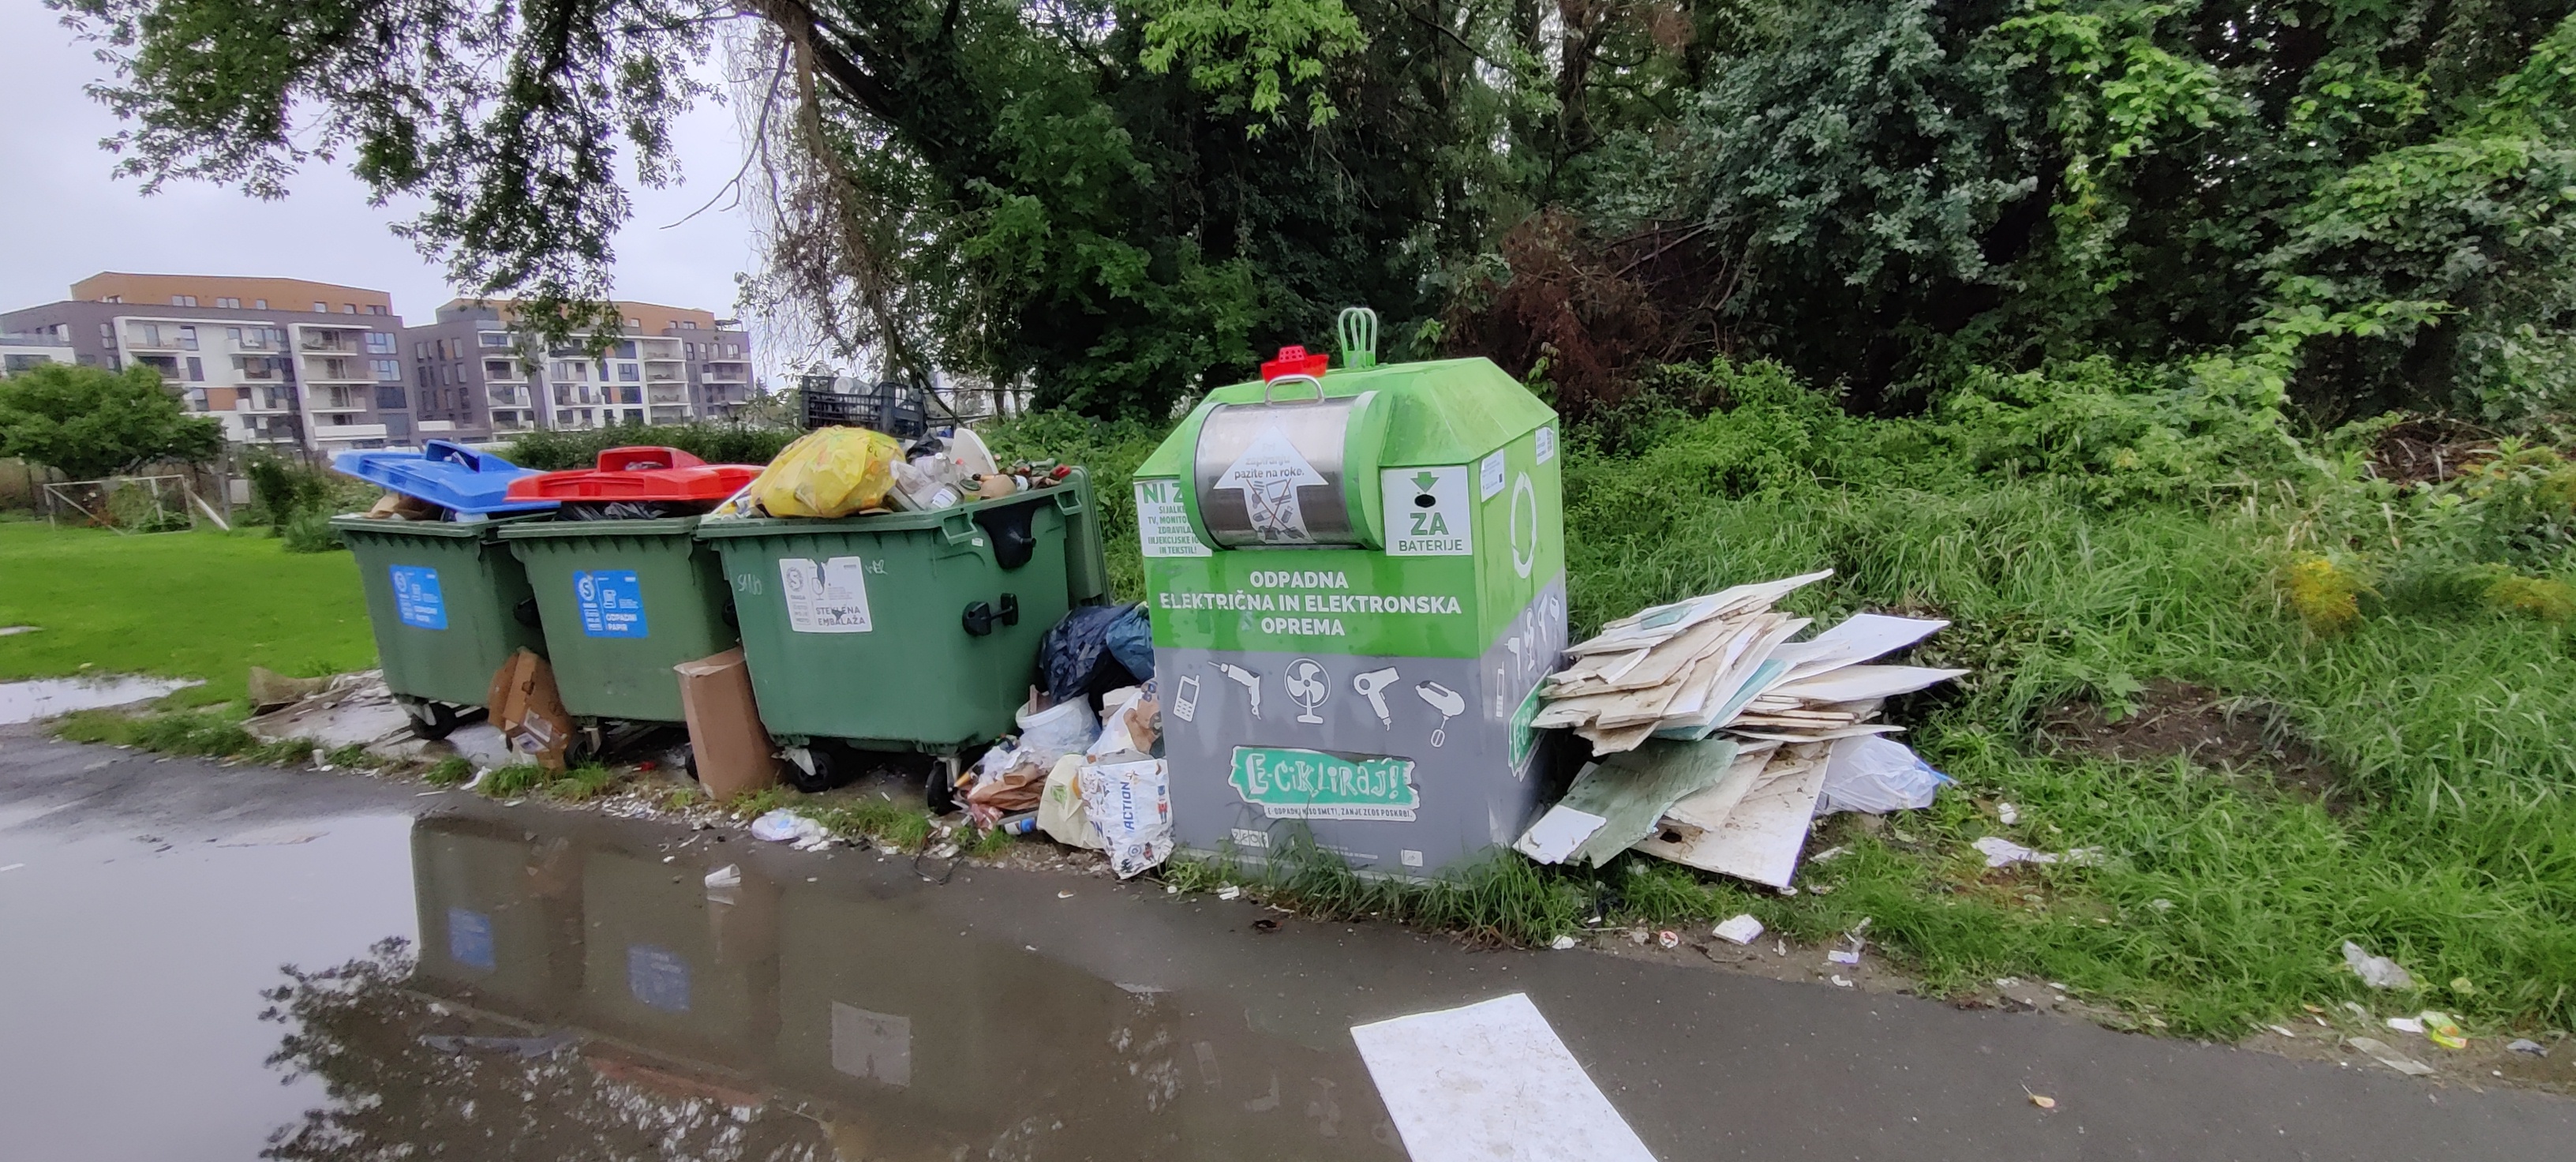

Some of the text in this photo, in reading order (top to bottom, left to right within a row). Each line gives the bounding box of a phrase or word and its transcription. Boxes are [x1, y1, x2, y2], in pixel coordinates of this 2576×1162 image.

[1234, 468, 1264, 480] pazite
[1280, 467, 1305, 477] roke.
[1142, 483, 1185, 504] NI Z
[1148, 516, 1159, 526] TV,
[1410, 512, 1450, 536] ZA
[1148, 536, 1192, 545] INJEKCIJSKE
[1398, 539, 1463, 552] BATERIJE
[1249, 571, 1350, 590] ODPADNA
[1159, 590, 1462, 614] ELEKTRIČNA IN ELEKTRONSKA
[818, 614, 866, 627] EMBALAŽA
[1260, 617, 1346, 636] OPREMA
[1120, 781, 1135, 830] ACTION
